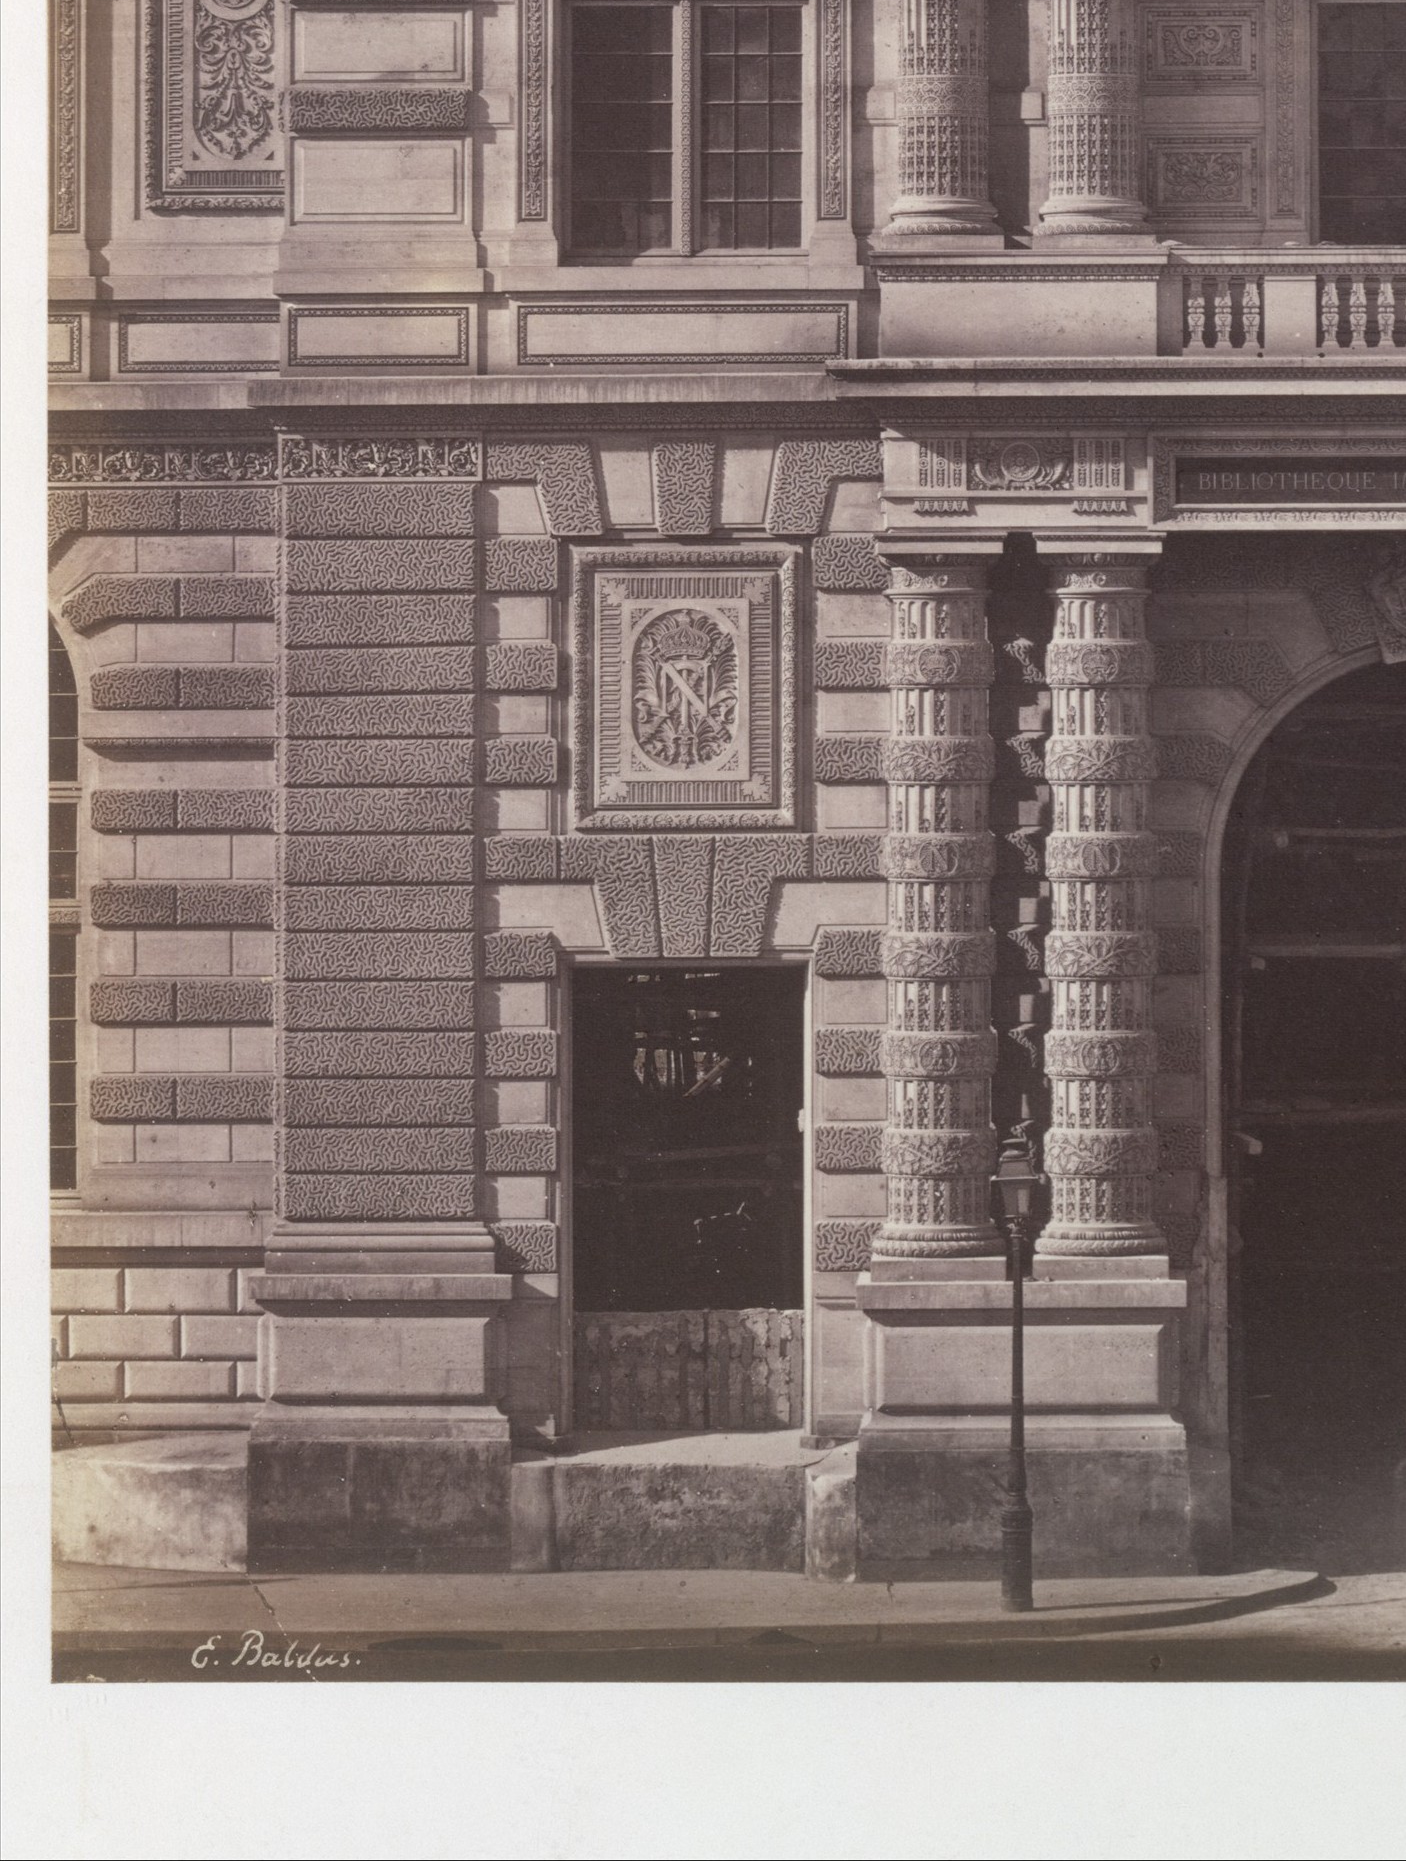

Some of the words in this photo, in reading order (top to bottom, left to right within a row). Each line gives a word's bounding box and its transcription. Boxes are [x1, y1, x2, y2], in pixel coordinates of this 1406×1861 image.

[1199, 471, 1377, 492] BIBLIOTHEQUE
[191, 1634, 221, 1669] E.
[231, 1629, 361, 1668] Baldus.
